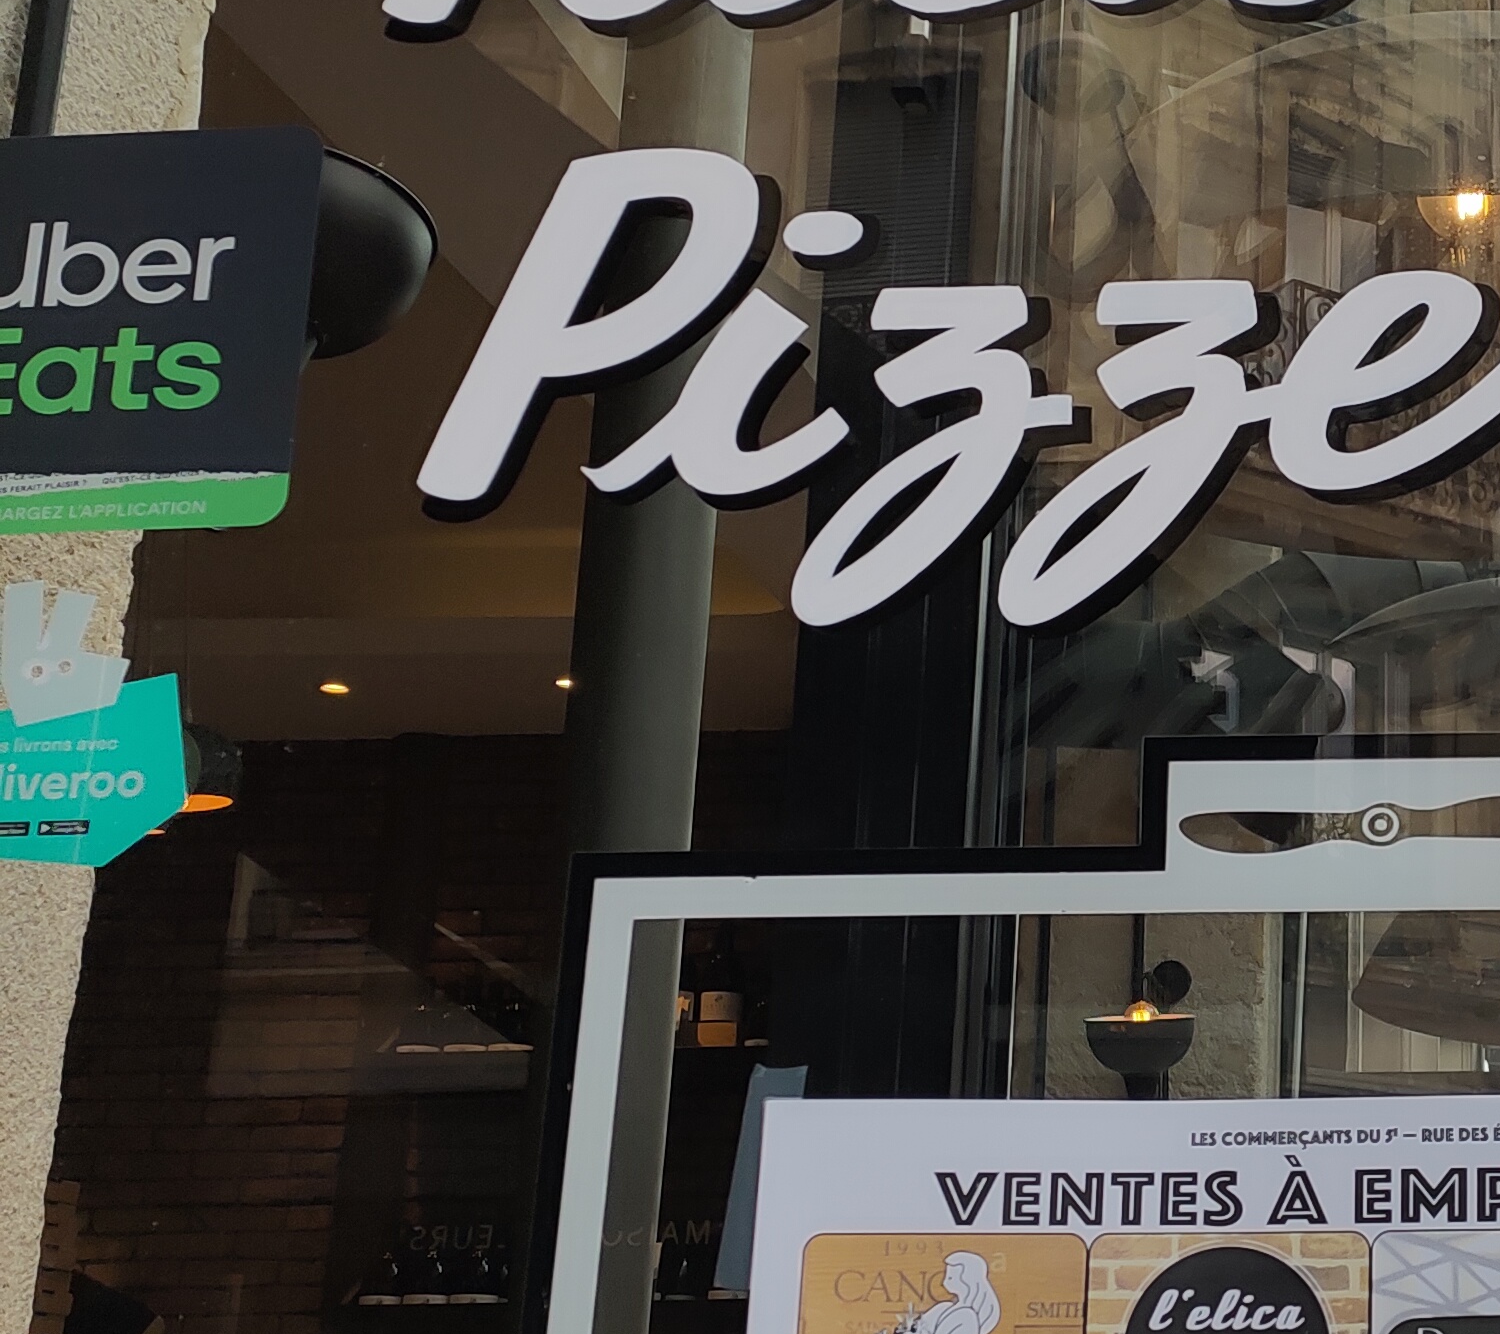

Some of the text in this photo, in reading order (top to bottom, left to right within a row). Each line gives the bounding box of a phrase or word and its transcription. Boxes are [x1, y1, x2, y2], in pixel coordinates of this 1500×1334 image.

[2, 499, 207, 521] ARGEZ L'APPLICATION
[14, 737, 119, 753] livrons avec
[1191, 1132, 1217, 1147] LES
[1221, 1130, 1352, 1149] COMMERÇANTS
[1357, 1128, 1381, 1144] DU
[1421, 1127, 1454, 1142] RUE
[1458, 1126, 1489, 1142] DES
[935, 1170, 1243, 1227] VENTES
[1267, 1154, 1328, 1225] À
[1148, 1288, 1305, 1331] l'elica
